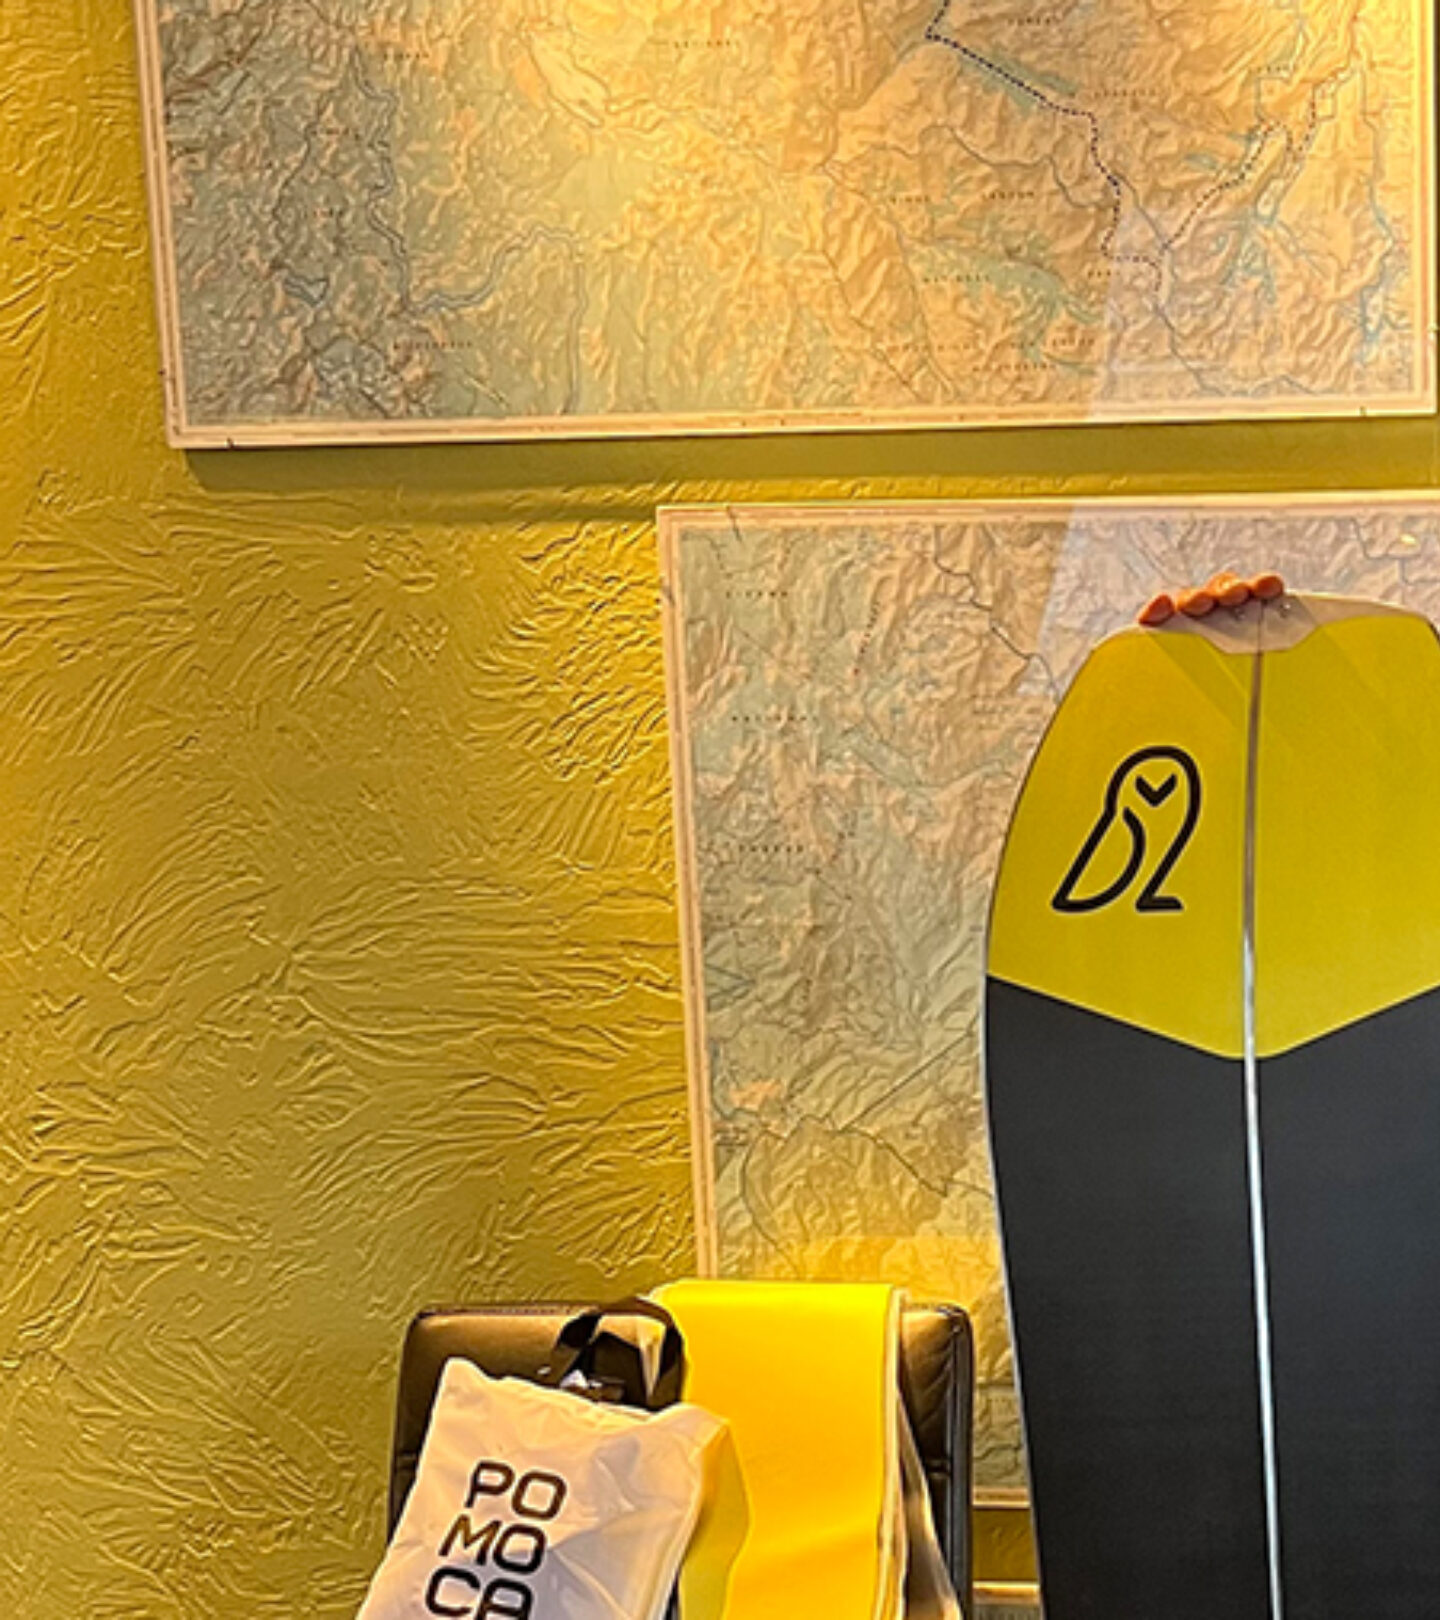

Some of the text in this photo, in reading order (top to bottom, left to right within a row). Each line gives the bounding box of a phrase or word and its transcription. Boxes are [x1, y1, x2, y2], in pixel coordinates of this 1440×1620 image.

[464, 1459, 568, 1521] PO
[438, 1513, 547, 1575] MO
[425, 1566, 533, 1620] CA
